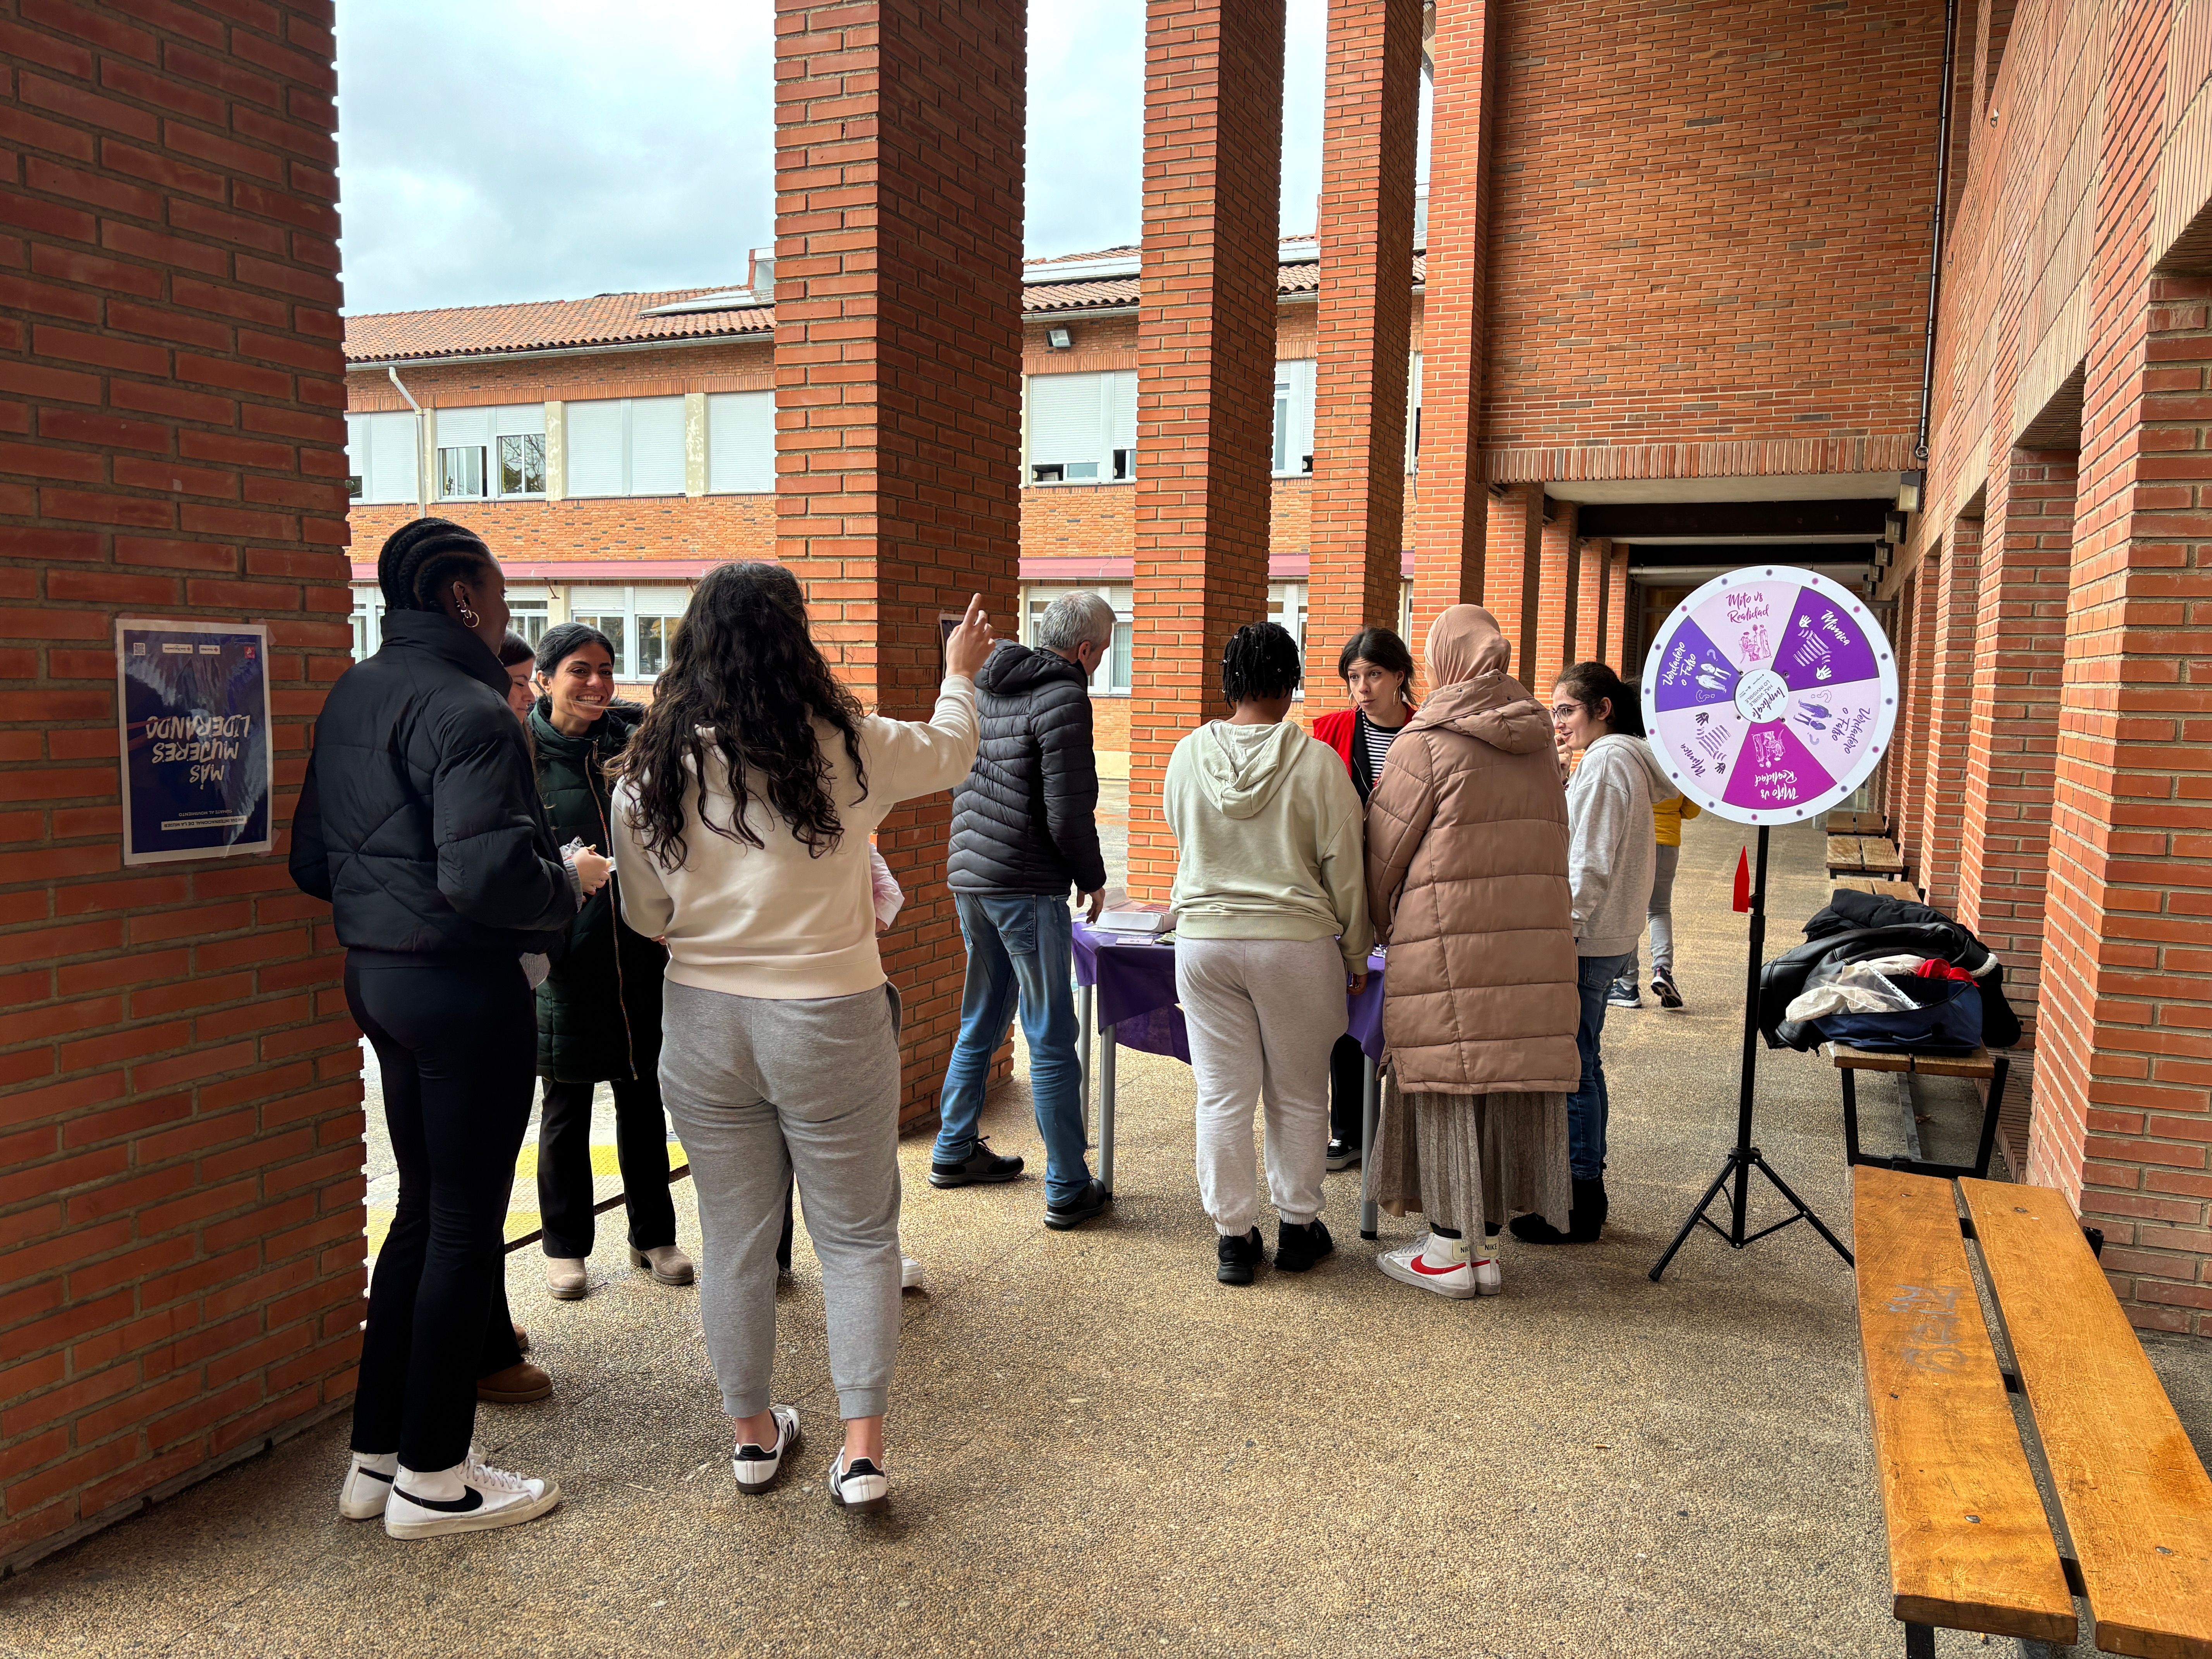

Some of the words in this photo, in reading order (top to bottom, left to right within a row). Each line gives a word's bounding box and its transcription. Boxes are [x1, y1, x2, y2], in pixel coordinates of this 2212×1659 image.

[1726, 592, 1752, 610] Mito
[1754, 591, 1763, 602] vs
[1727, 604, 1769, 623] Realidad
[1662, 642, 1686, 685] Verdadero
[1680, 653, 1696, 676] Falso
[1745, 685, 1764, 704] INVISIBLE
[1764, 684, 1773, 694] HAZ
[1749, 692, 1765, 707] VISIBLE
[146, 714, 251, 740] LIDERANDO
[1832, 718, 1850, 741] Falso
[1843, 708, 1872, 754] Verdadero
[152, 738, 239, 764] MUJERES
[189, 764, 225, 790] MÁS
[1754, 769, 1797, 787] Realidad
[1760, 789, 1770, 800] vs
[1772, 783, 1799, 800] Mito
